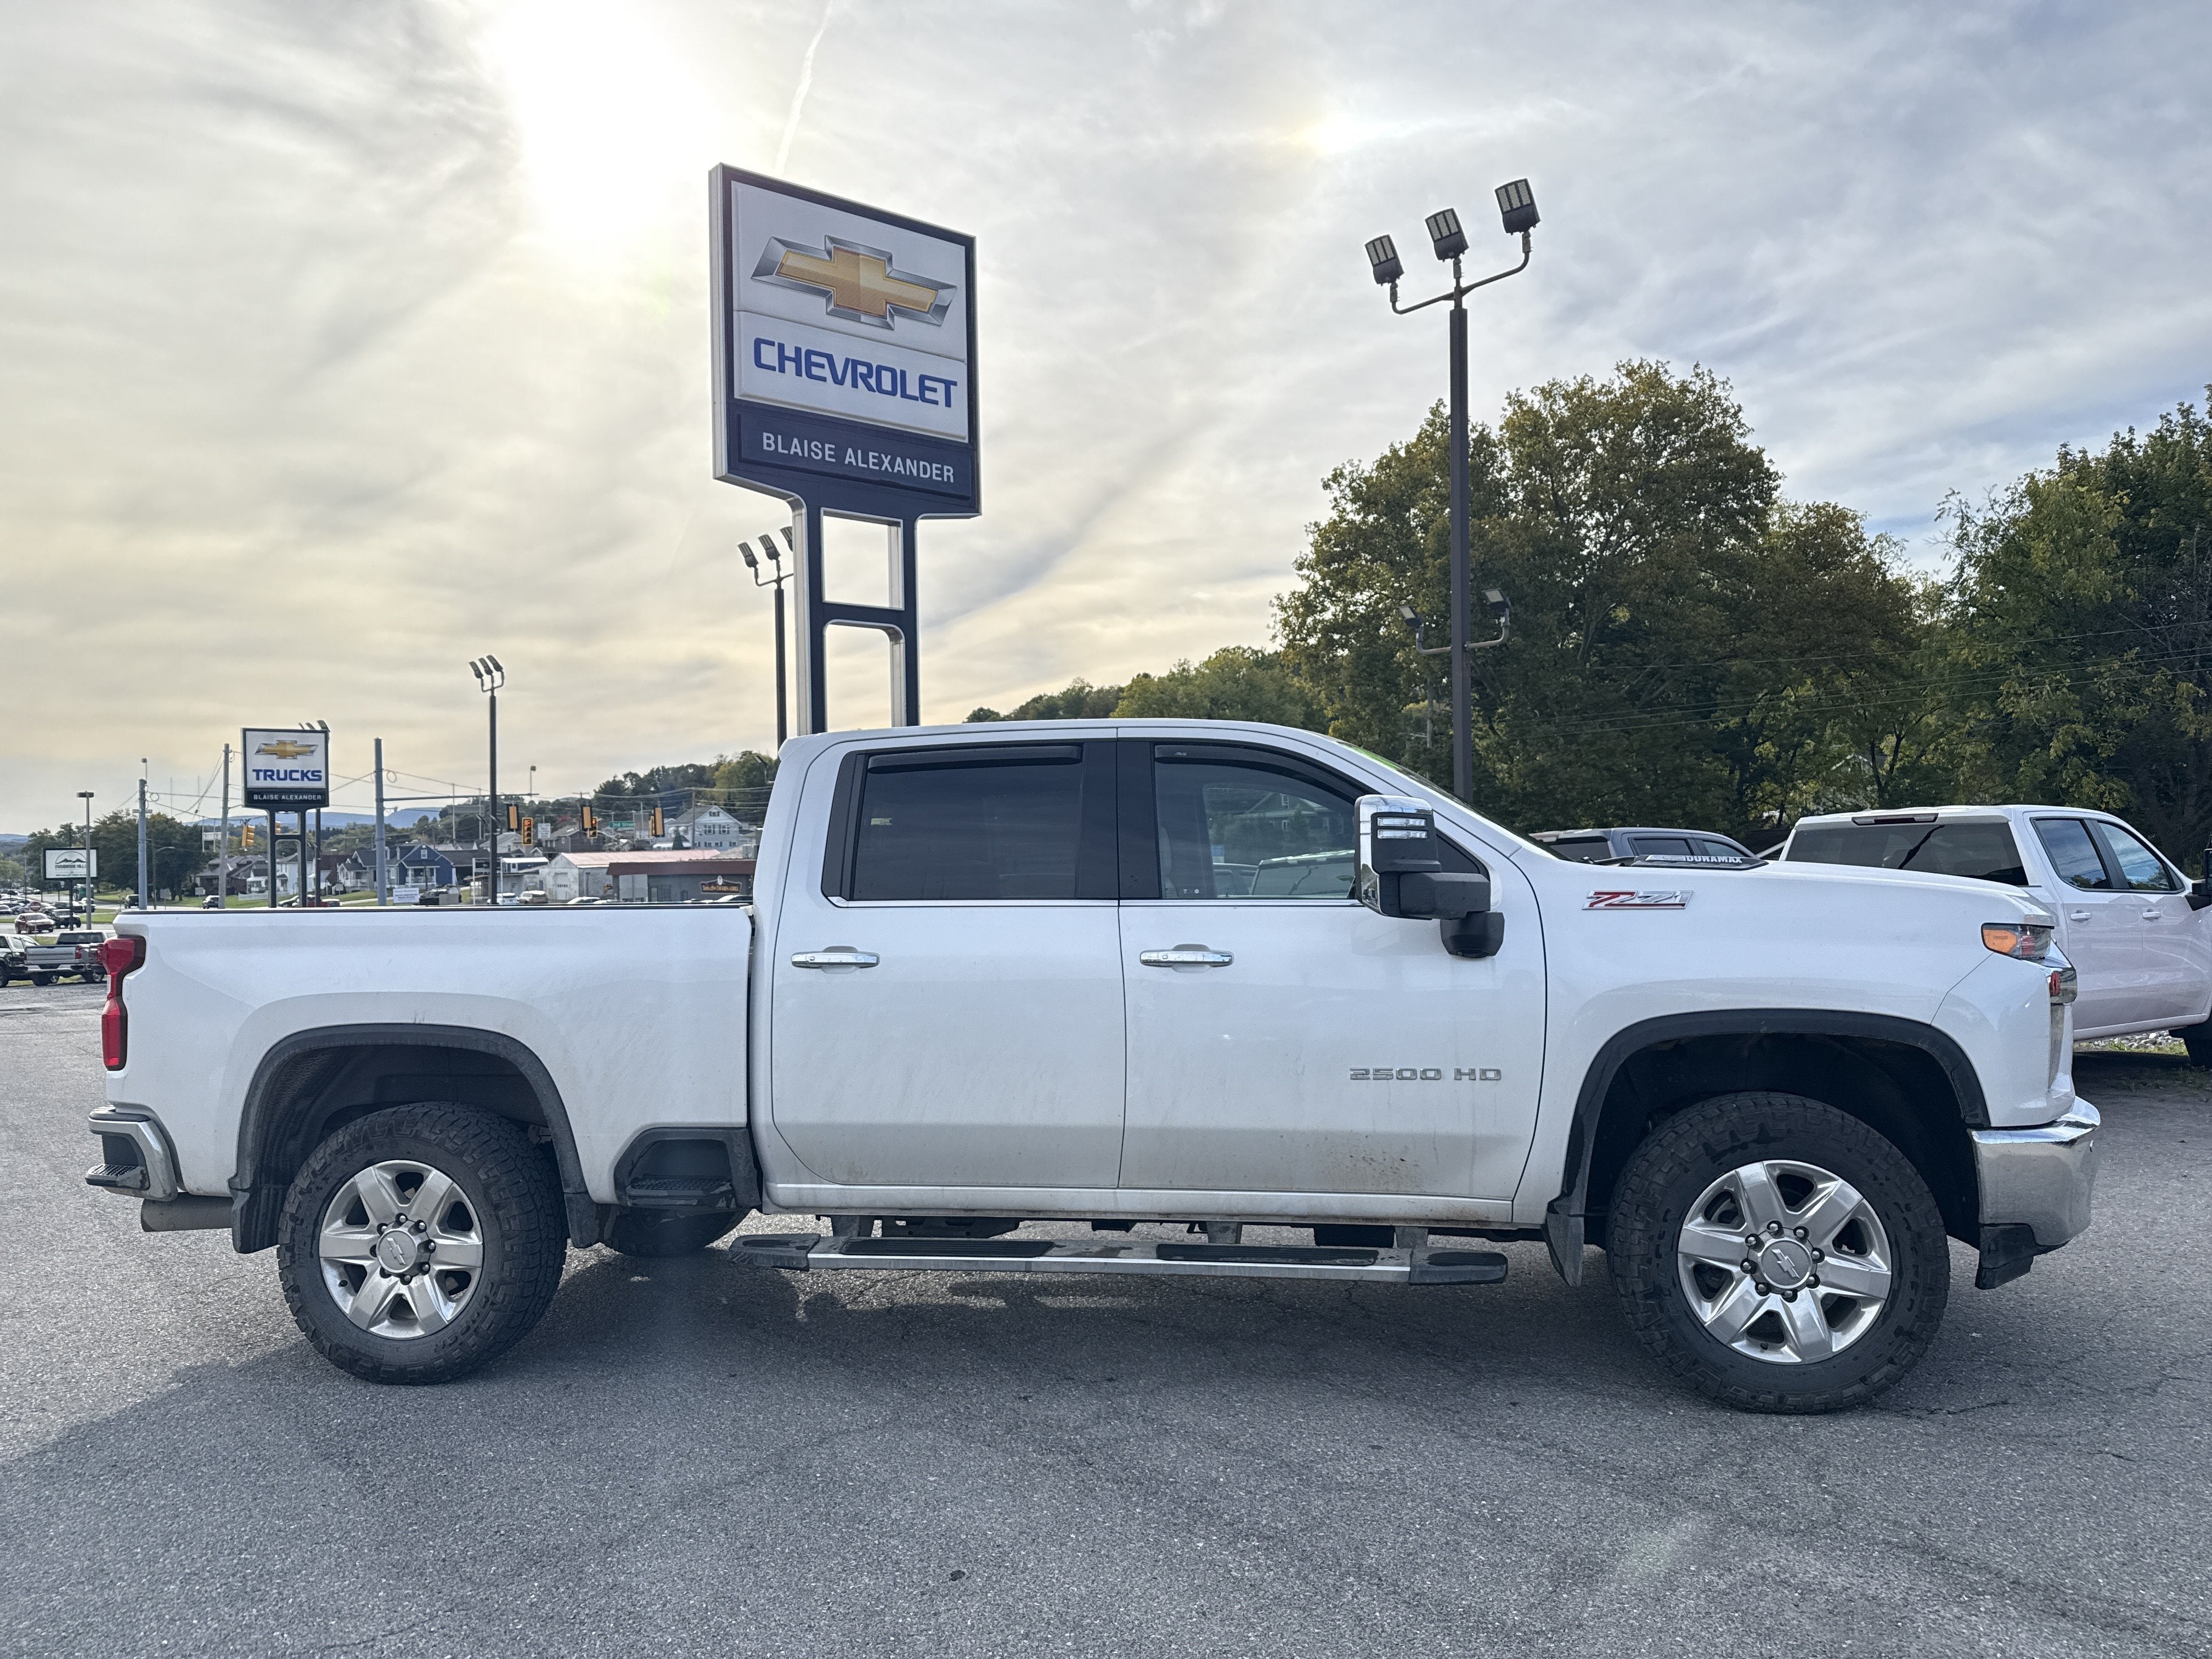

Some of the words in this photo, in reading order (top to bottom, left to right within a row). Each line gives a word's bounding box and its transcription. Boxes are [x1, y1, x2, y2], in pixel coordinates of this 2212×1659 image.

[754, 337, 957, 408] CHEVROLET
[763, 432, 836, 462] BLAISE
[844, 448, 954, 483] ALEXANDER
[252, 769, 322, 781] TRUCKS
[1685, 855, 1742, 864] DURAMAX
[1582, 890, 1694, 910] Z71
[1350, 1068, 1442, 1080] 2500
[1454, 1068, 1502, 1080] HD
